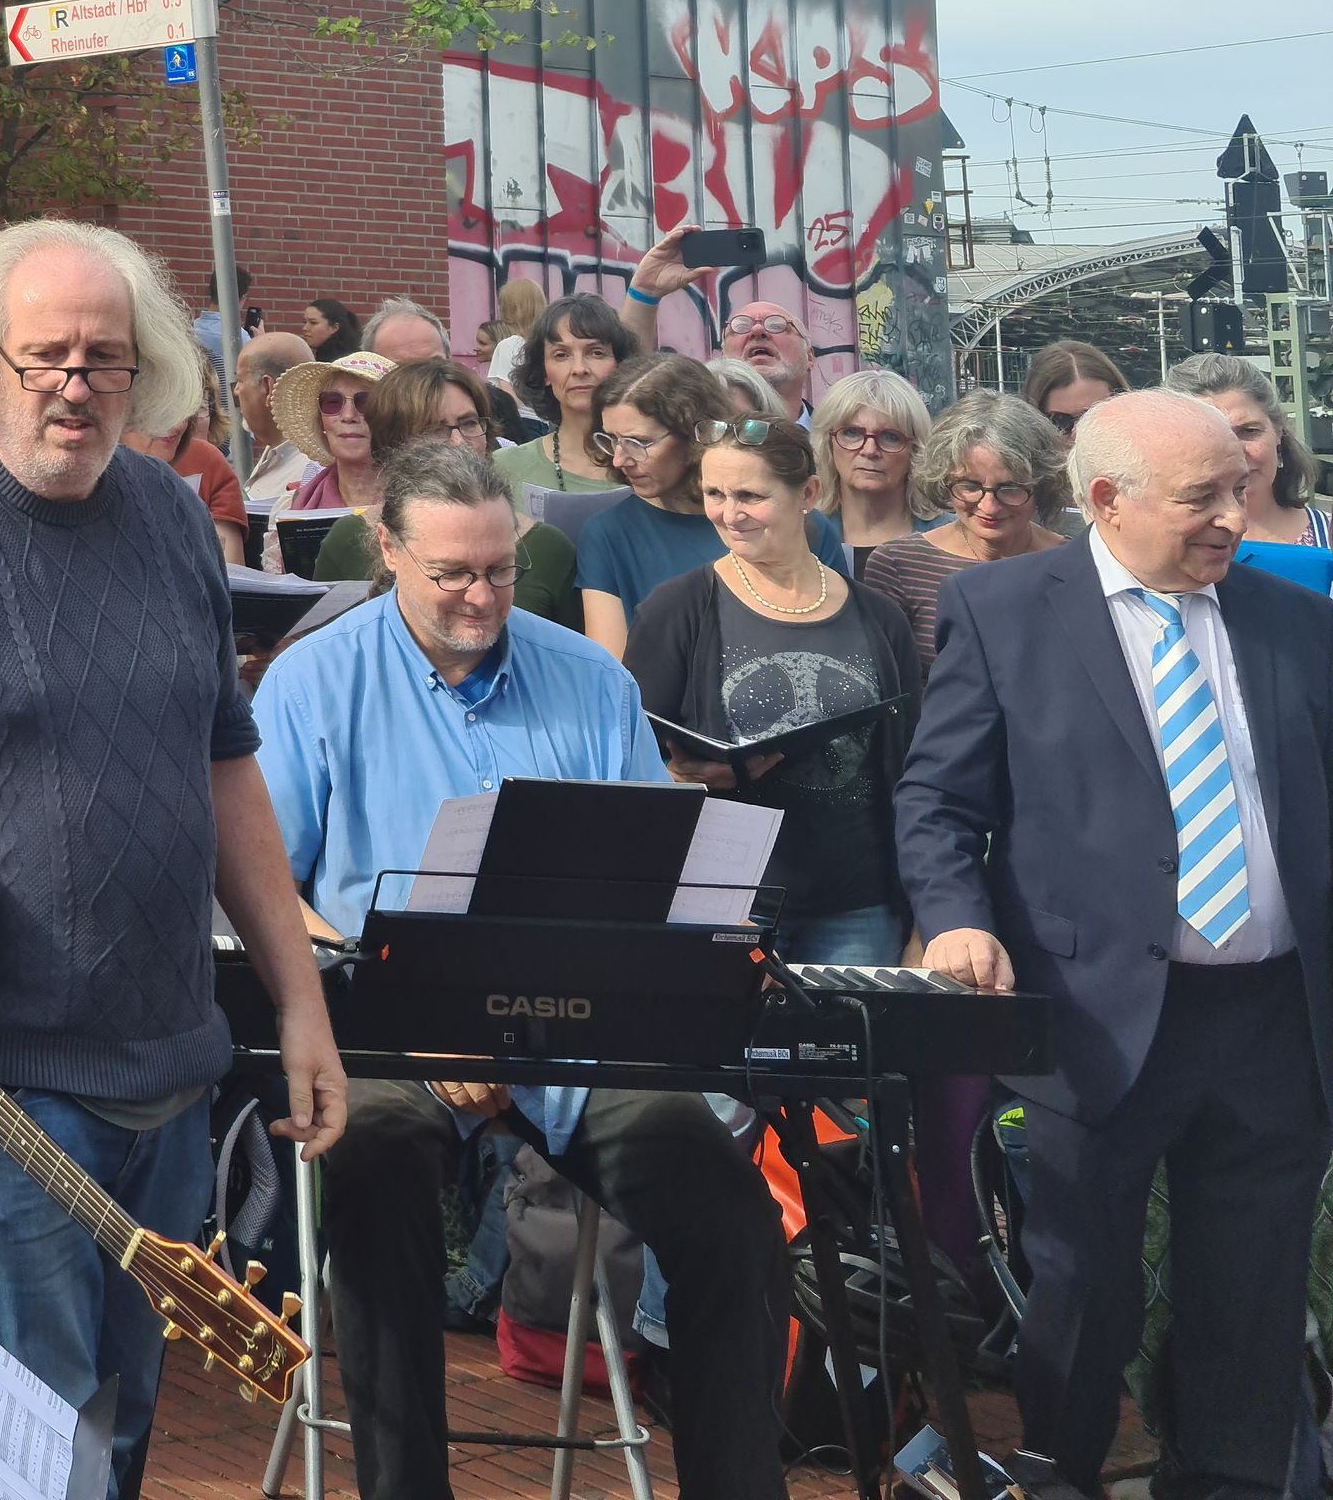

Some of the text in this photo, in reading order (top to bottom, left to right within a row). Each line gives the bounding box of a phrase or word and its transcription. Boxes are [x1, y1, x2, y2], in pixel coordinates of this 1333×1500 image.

[56, 10, 70, 28] R
[71, 1, 117, 21] Altstadt
[51, 32, 109, 54] Rheinufer
[808, 212, 852, 251] 25
[486, 994, 591, 1019] CASIO
